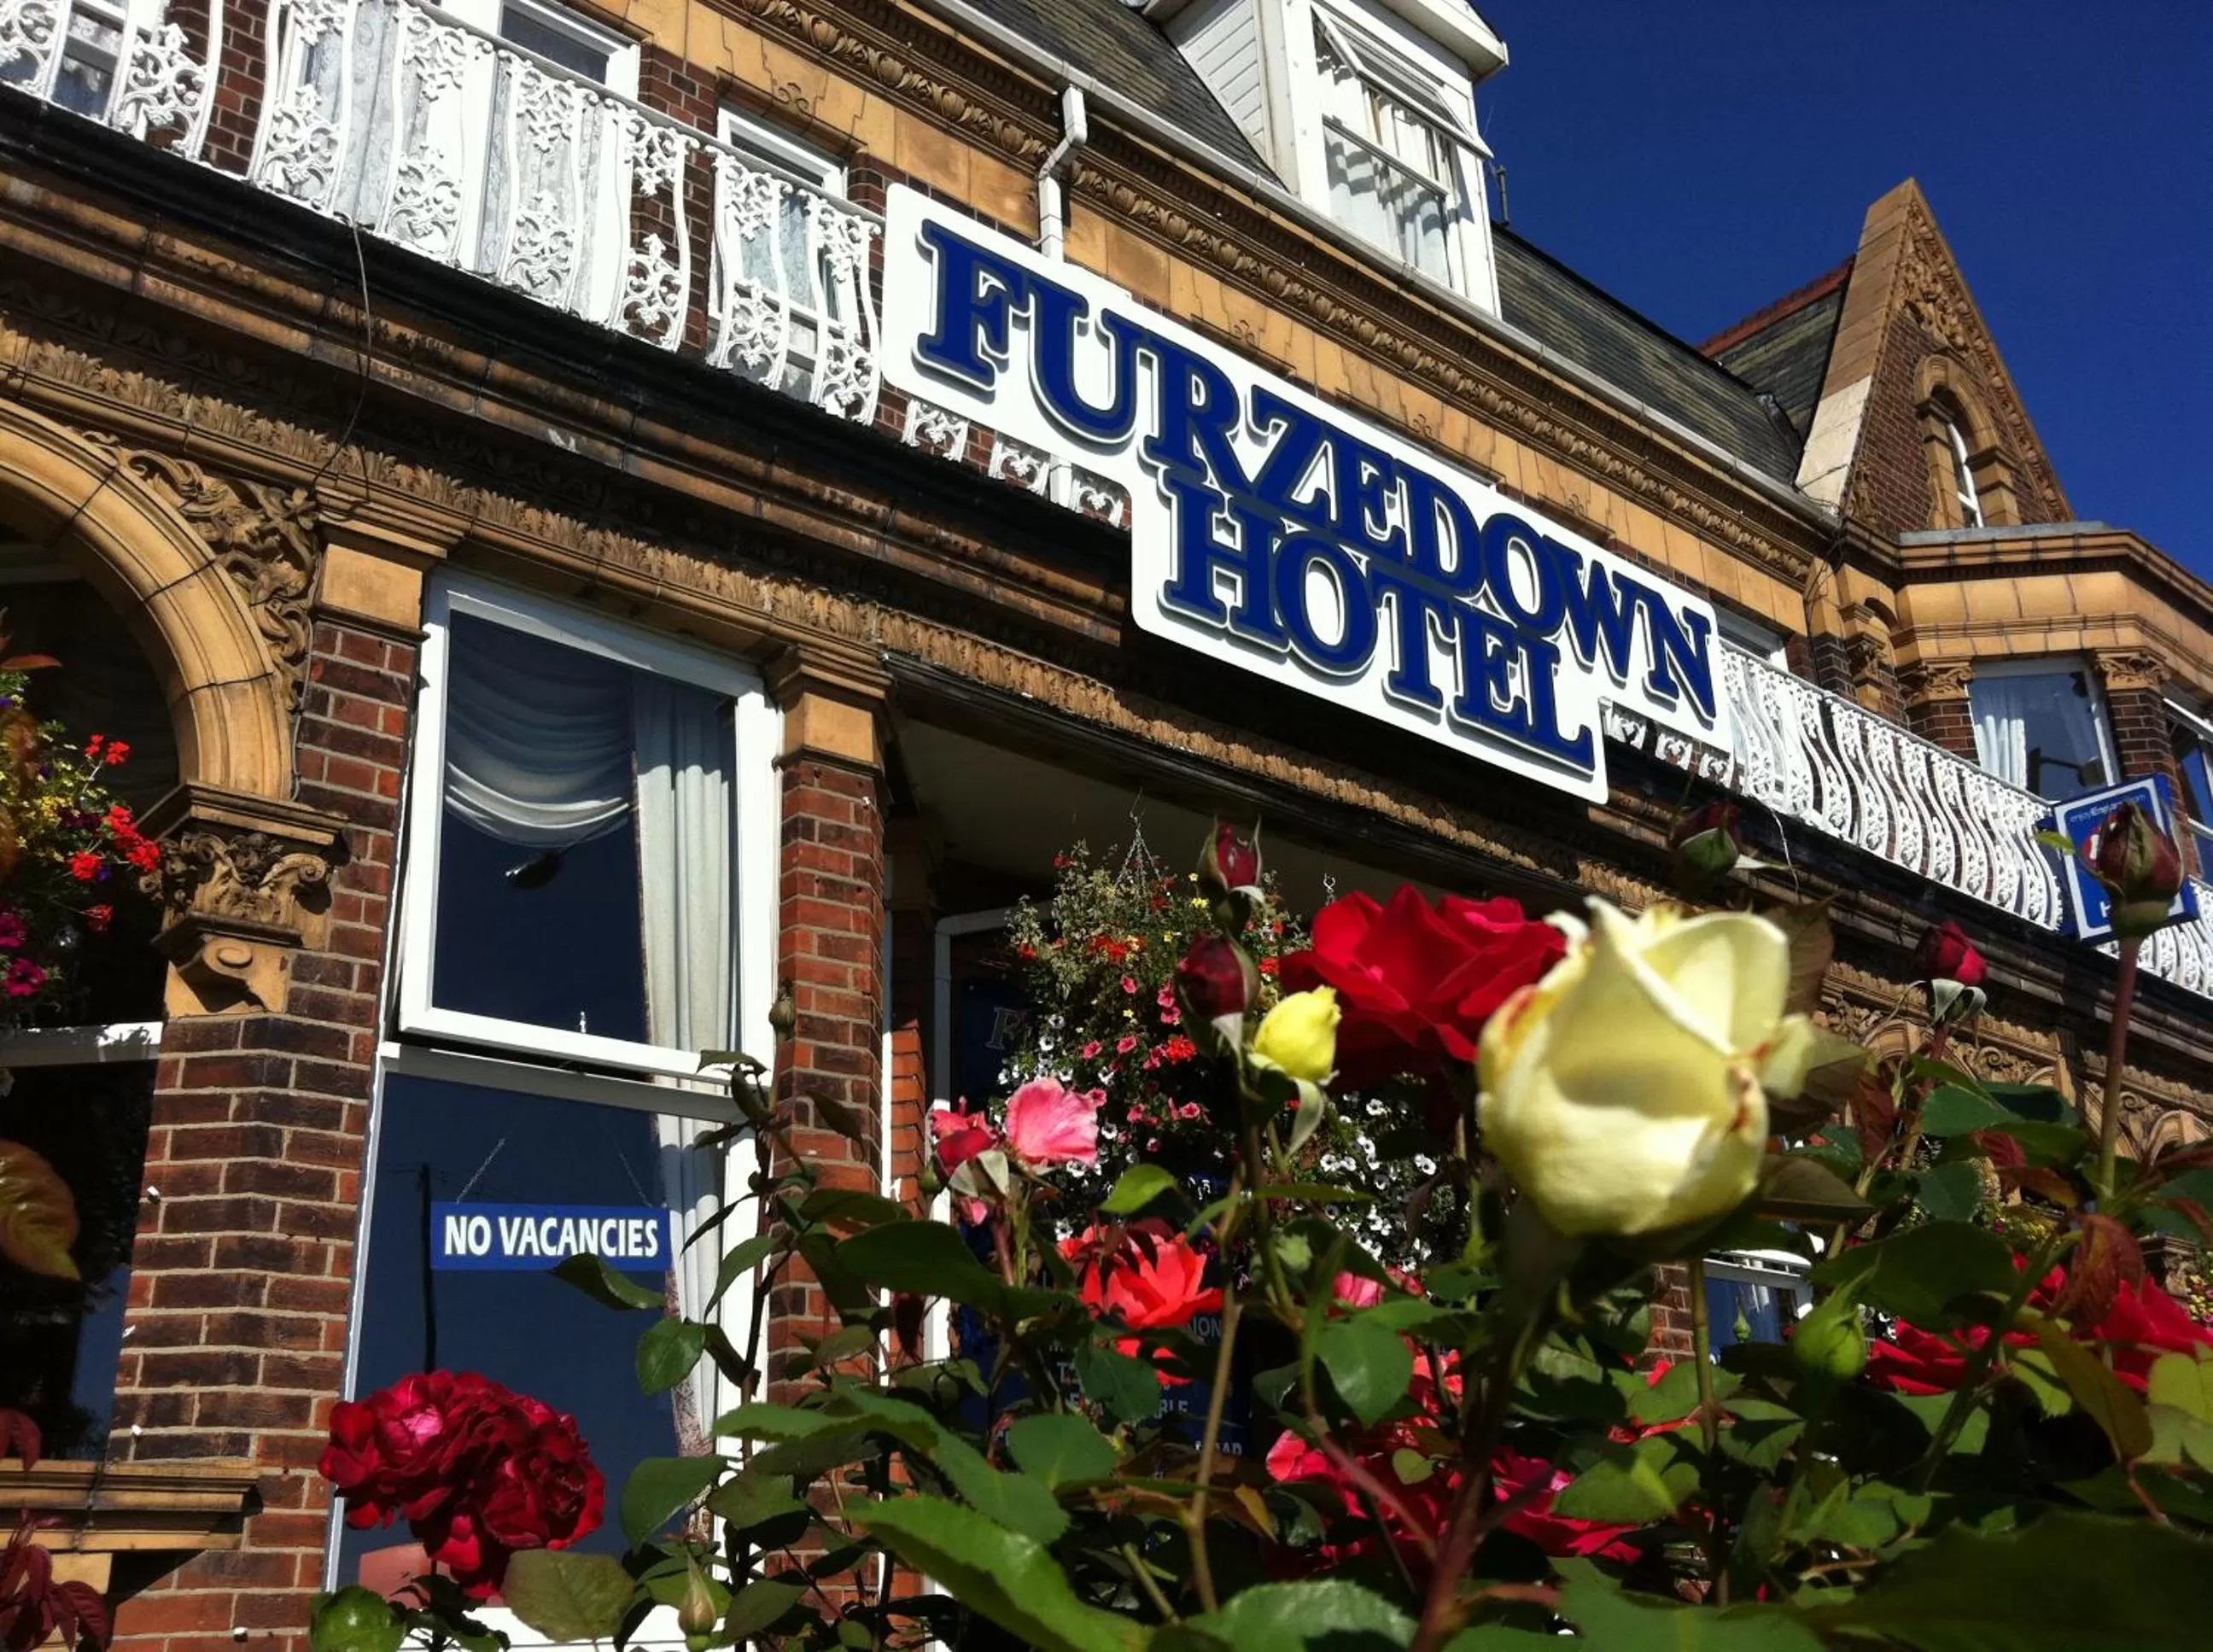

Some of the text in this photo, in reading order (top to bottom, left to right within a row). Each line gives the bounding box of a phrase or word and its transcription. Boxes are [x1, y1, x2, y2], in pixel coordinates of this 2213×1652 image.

[914, 219, 1715, 728] FURZEDOWN
[1159, 468, 1596, 778] HOTEL
[444, 1216, 658, 1257] NO VACANCIES
